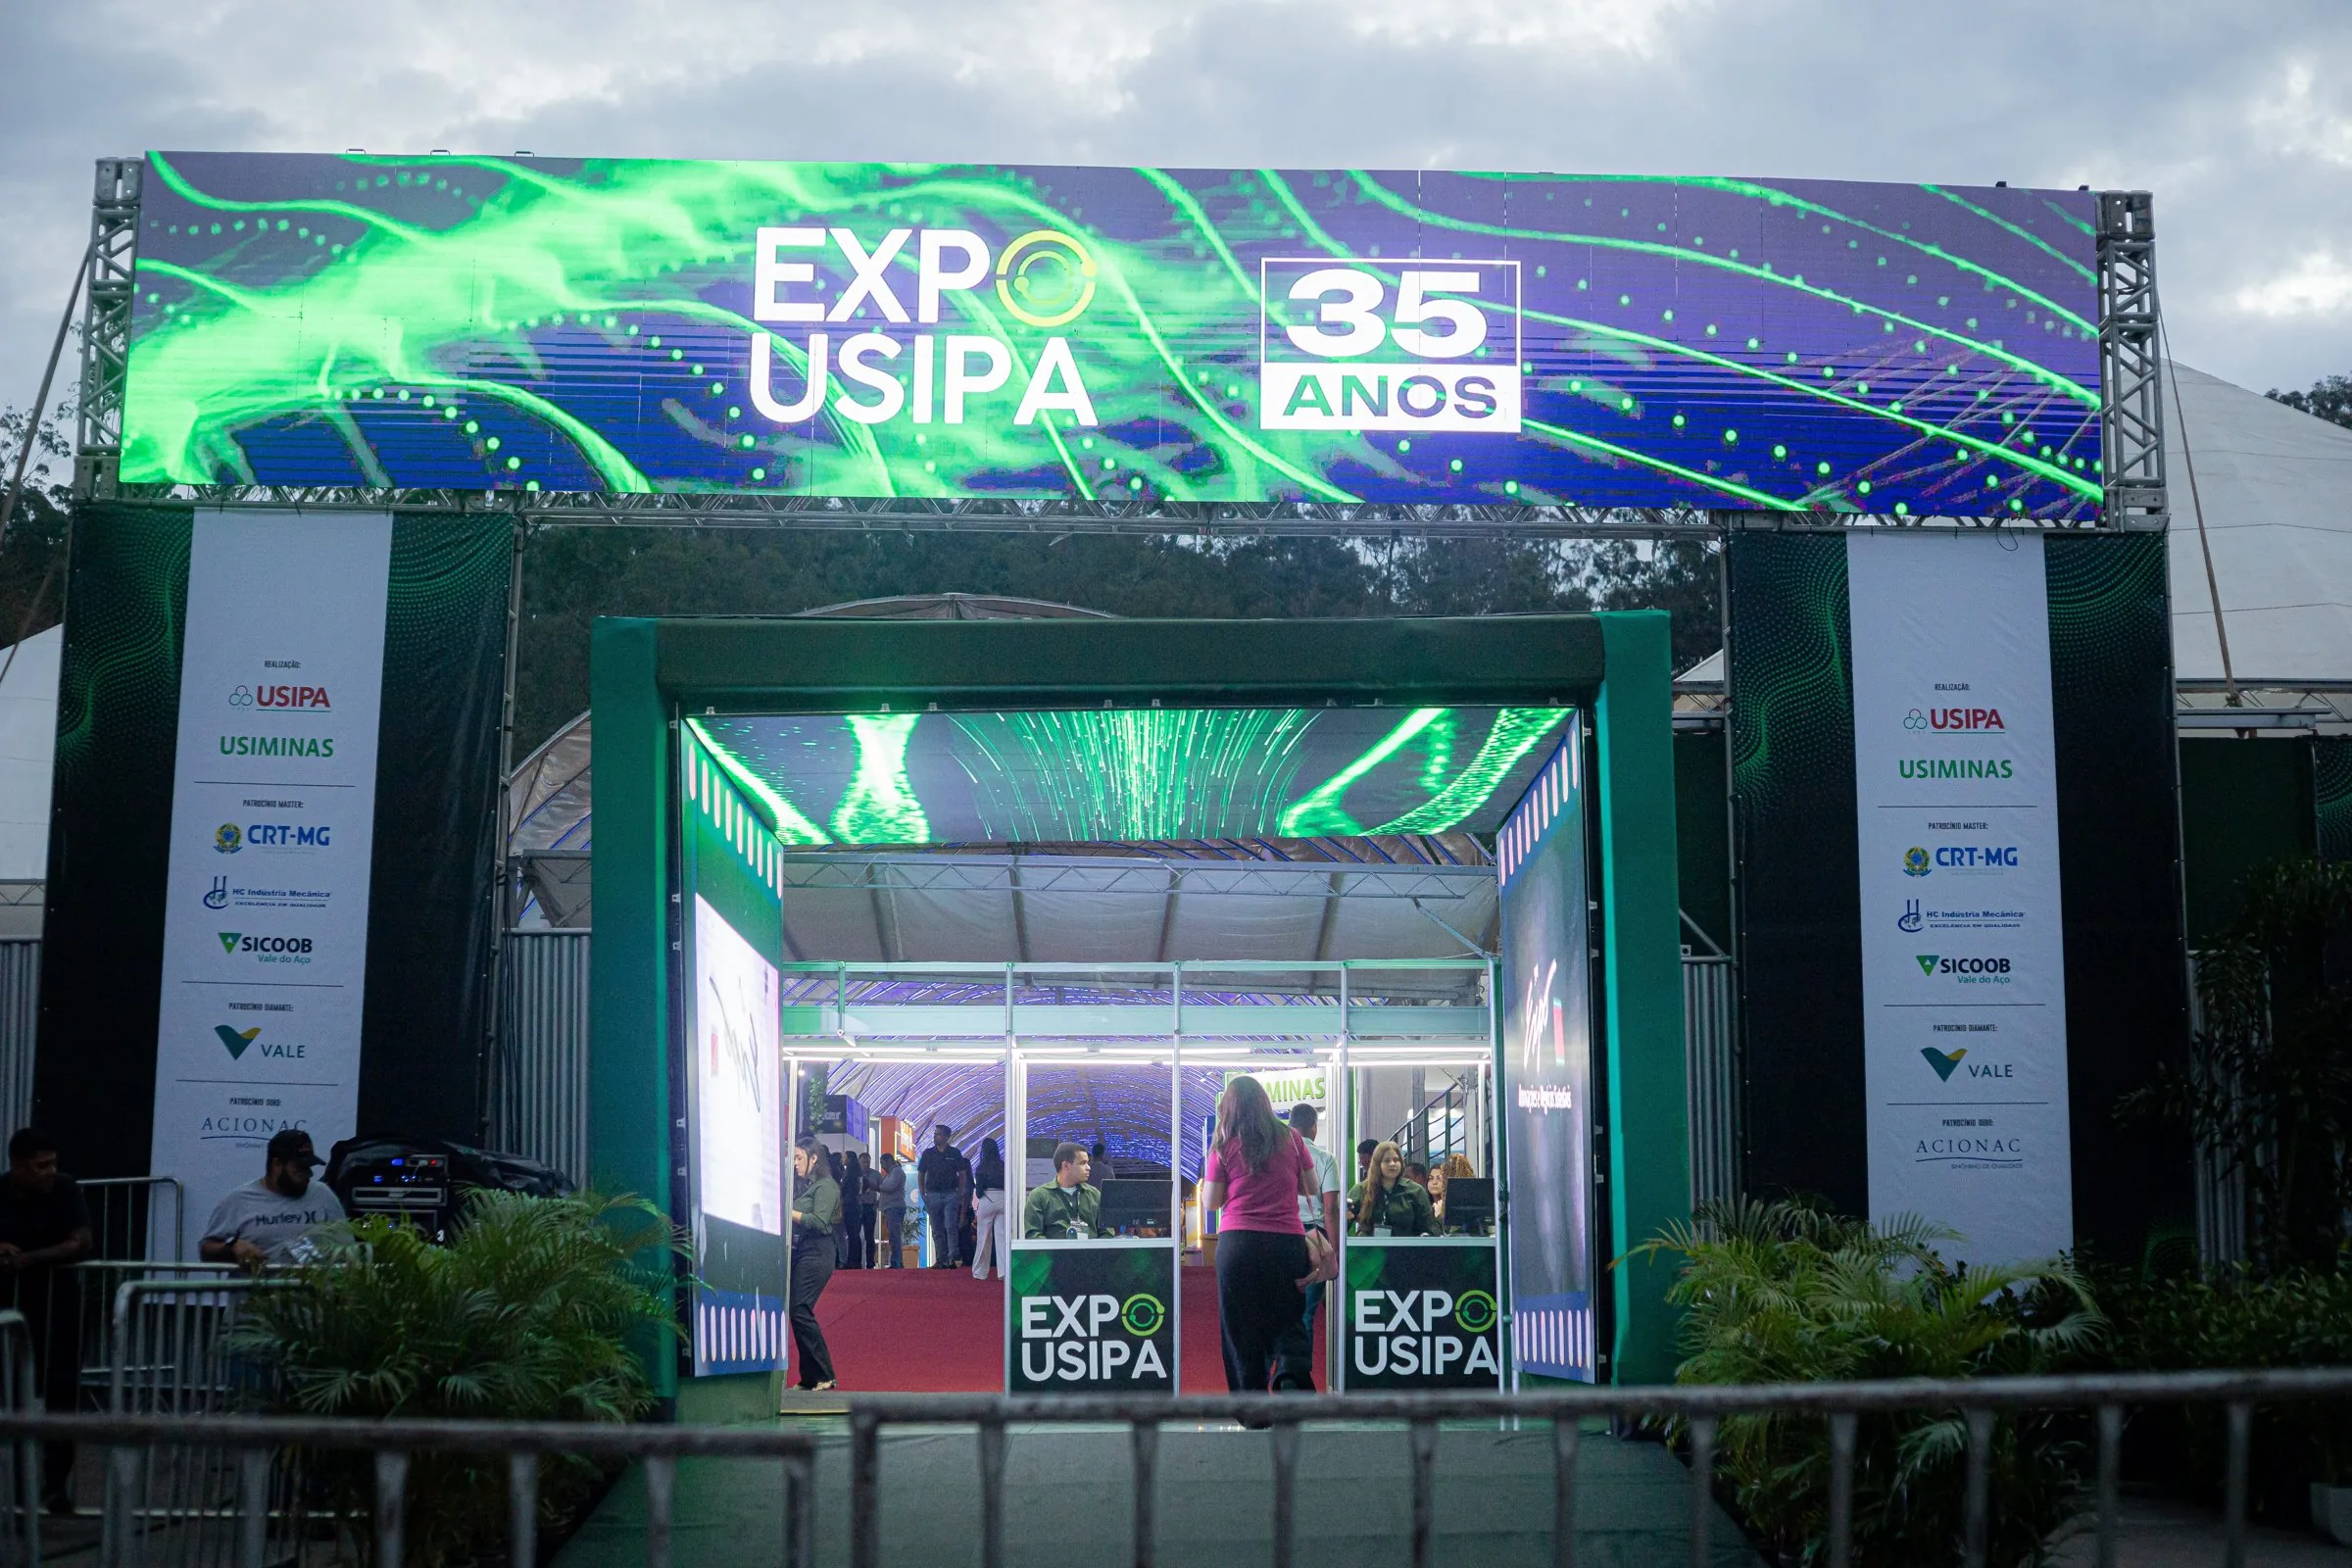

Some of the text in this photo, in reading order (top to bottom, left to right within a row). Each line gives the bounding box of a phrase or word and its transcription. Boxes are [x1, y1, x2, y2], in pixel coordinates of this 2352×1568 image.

[754, 226, 1097, 327] EXPO
[1284, 269, 1488, 359] 35
[750, 333, 1099, 426] USIPA
[1283, 375, 1499, 418] ANOS
[265, 660, 301, 669] REALIZAÇÃO:
[257, 685, 330, 708] USIPA
[1935, 683, 1971, 692] REALIZAÇÃO:
[1931, 709, 2005, 729] USIPA
[220, 736, 333, 758] USIMINAS
[1899, 760, 2013, 779] USIMINAS
[243, 799, 276, 808] PATROCÍNIO
[1929, 820, 1961, 830] PATROCÍNIO
[247, 824, 330, 846] CRT-MG
[1936, 847, 2018, 866] CRT-MG
[241, 936, 313, 954] SICOOB
[279, 955, 291, 963] do
[293, 956, 311, 965] Aço
[1940, 957, 2011, 973] SICOOB
[1992, 975, 2010, 985] Aço
[1934, 1023, 1967, 1032] PATROCÍNIO
[261, 1044, 306, 1058] VALE
[1968, 1064, 2013, 1078] VALE
[1942, 1118, 1976, 1127] PATROCÍNIO
[1916, 1139, 2021, 1153] ACIONAC
[255, 1210, 301, 1225] Hurley
[1022, 1294, 1165, 1338] EXPO
[1354, 1290, 1497, 1333] EXPO
[1022, 1339, 1167, 1382] USIPA
[1354, 1335, 1499, 1376] USIPA
